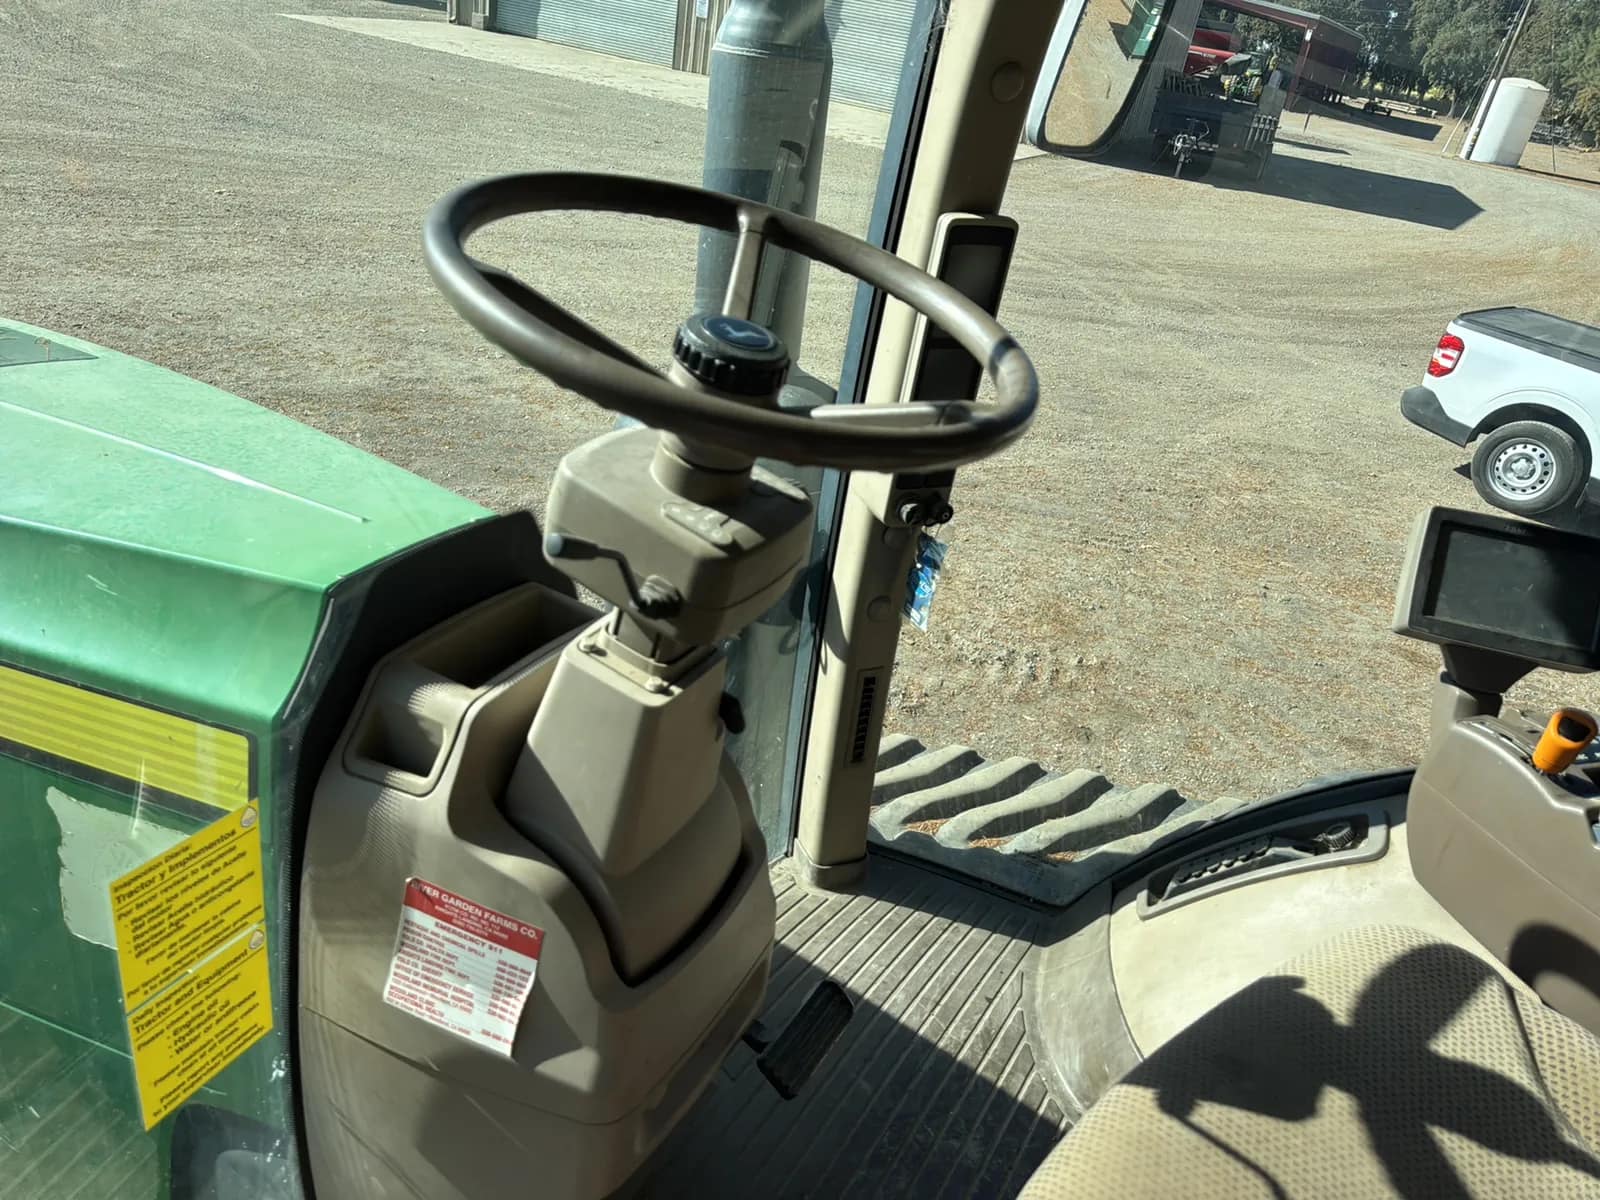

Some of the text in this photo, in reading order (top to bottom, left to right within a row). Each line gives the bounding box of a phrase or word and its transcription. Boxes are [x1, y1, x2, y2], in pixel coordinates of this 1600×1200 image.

[116, 826, 236, 905] Tractor y Implementos
[131, 901, 162, 925] Revisar
[181, 873, 208, 894] niveles
[211, 865, 220, 876] de
[223, 849, 246, 868] Aceite
[117, 906, 132, 921] Por
[135, 892, 156, 909] favor
[160, 873, 188, 894] revisar
[131, 903, 172, 933] del motor
[440, 893, 482, 916] GARDEN
[483, 911, 518, 931] FARMS
[519, 925, 538, 939] CO.
[133, 917, 164, 942] Revisar
[167, 899, 192, 920] Aceite
[168, 911, 189, 931] Agua
[434, 921, 485, 947] EMERGENCY
[487, 943, 502, 954] 911
[135, 948, 247, 1034] Tractor and Equipment
[137, 1027, 164, 1051] Please
[166, 1009, 189, 1029] check
[191, 998, 203, 1011] the
[172, 998, 217, 1037] Engine oil
[174, 998, 229, 1047] Hydraulic oil
[175, 1031, 200, 1055] Water
[203, 1022, 212, 1034] or
